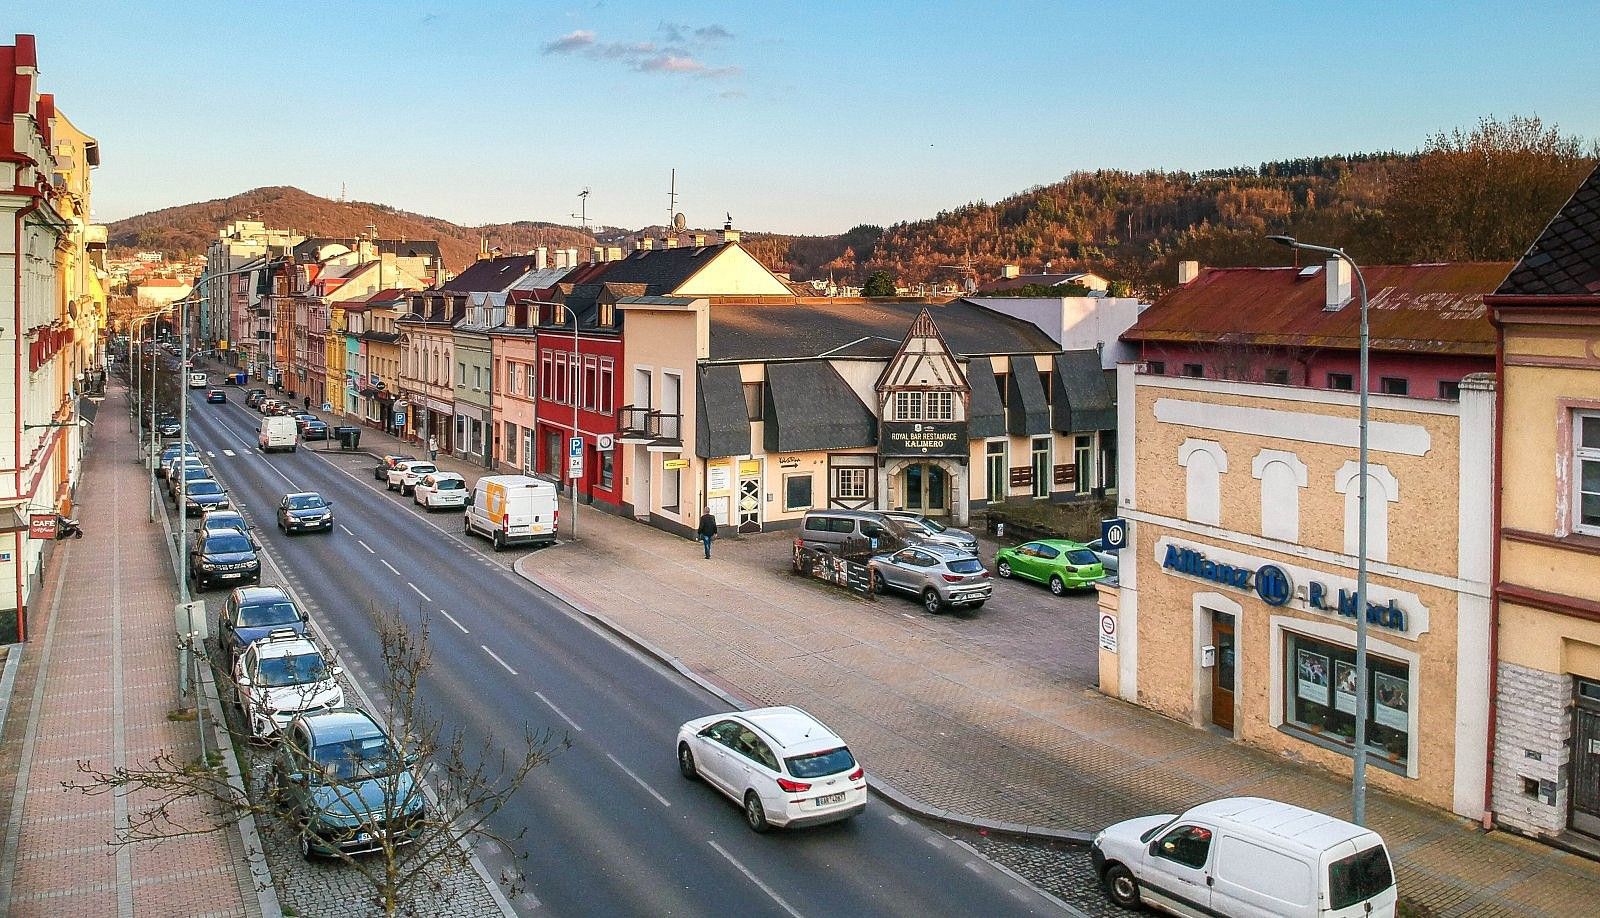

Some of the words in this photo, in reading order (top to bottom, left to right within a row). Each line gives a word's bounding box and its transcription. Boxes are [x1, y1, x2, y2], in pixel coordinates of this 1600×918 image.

[891, 432, 908, 441] ROYAL
[910, 432, 921, 441] BAR
[922, 432, 957, 441] RESTAURACE
[572, 439, 580, 451] P
[904, 440, 944, 448] KALIMERO
[32, 518, 56, 527] CAFÉ
[1162, 544, 1253, 592] Allianz
